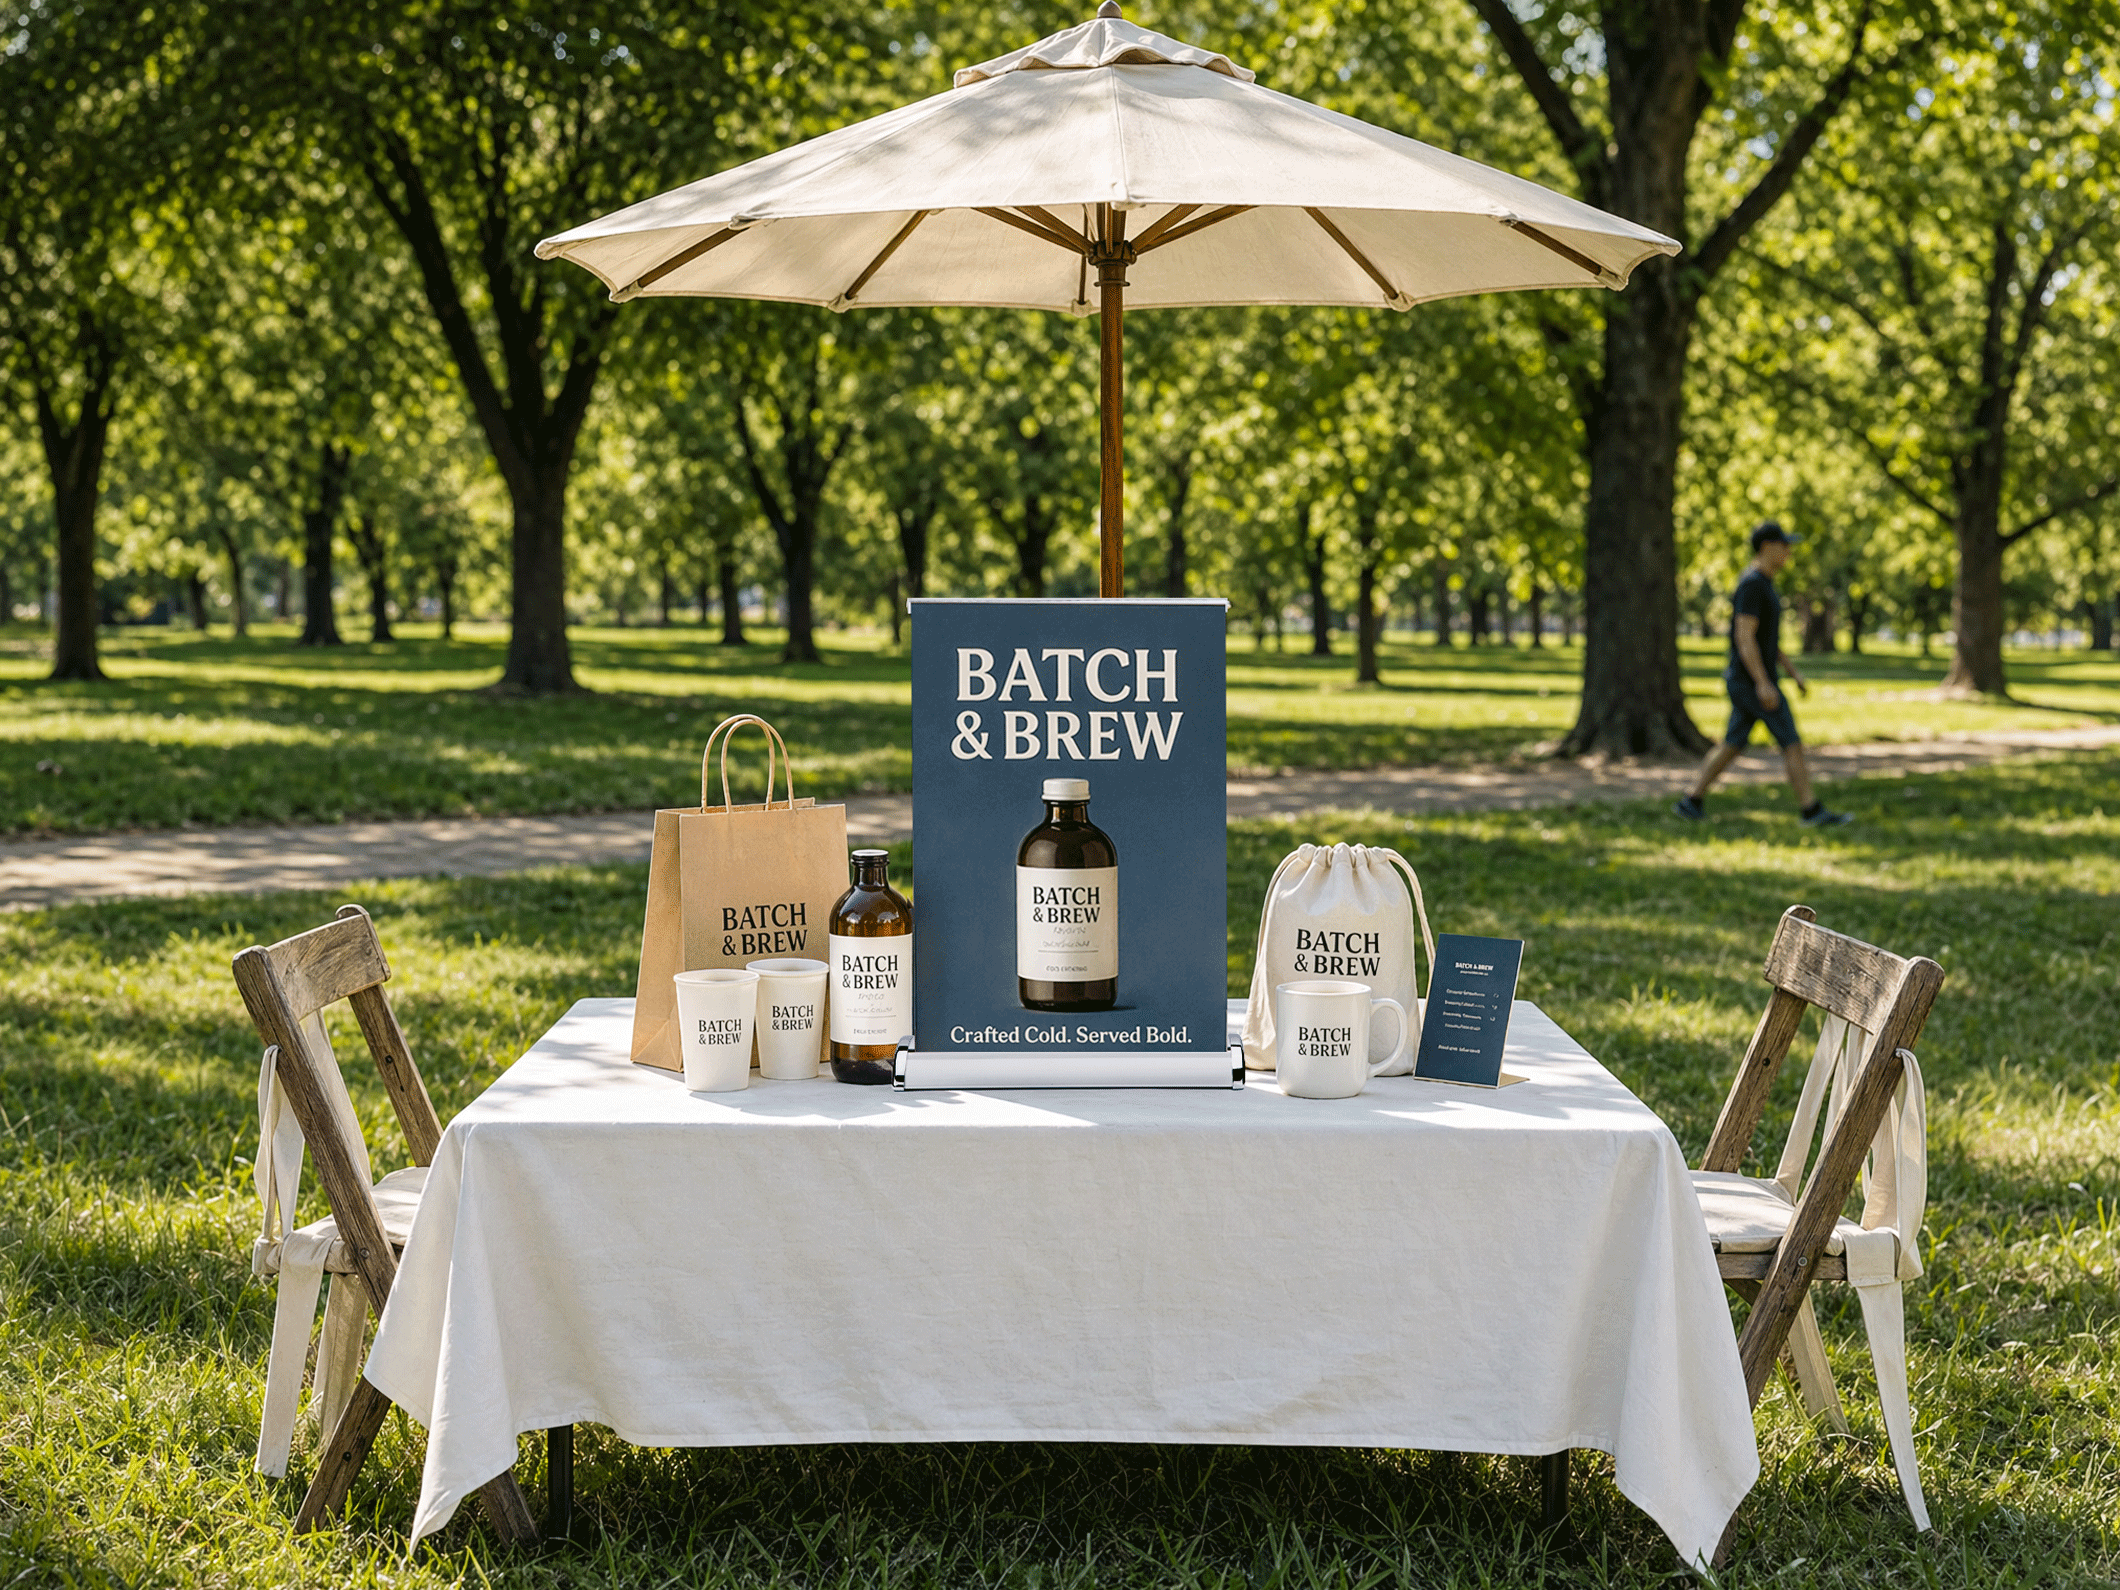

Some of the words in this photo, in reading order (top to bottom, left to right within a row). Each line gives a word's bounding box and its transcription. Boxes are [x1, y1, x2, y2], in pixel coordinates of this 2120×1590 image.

[956, 647, 1179, 703] BATCH
[951, 710, 993, 760] &
[1003, 710, 1184, 761] BREW
[1032, 886, 1101, 905] BATCH
[722, 902, 807, 931] BATCH
[1032, 907, 1044, 923] &
[1047, 906, 1101, 923] BREW
[721, 934, 737, 957] &
[741, 929, 808, 956] BREW
[1296, 928, 1380, 954] BATCH
[842, 954, 898, 973] BATCH
[1294, 953, 1309, 973] &
[1313, 954, 1381, 977] BREW
[842, 973, 851, 989] &
[853, 974, 899, 990] BREW
[772, 1004, 814, 1019] BATCH
[698, 1018, 742, 1033] BATCH
[771, 1019, 780, 1031] &
[781, 1018, 814, 1031] BREW
[698, 1033, 707, 1045] &
[708, 1032, 743, 1045] BREW
[950, 1025, 1020, 1044] Crafted
[1024, 1025, 1073, 1044] Cold.
[1076, 1025, 1141, 1044] Served
[1146, 1026, 1192, 1044] Bold.
[1298, 1026, 1351, 1043] BATCH
[1298, 1043, 1307, 1056] &
[1310, 1043, 1352, 1057] BREW
